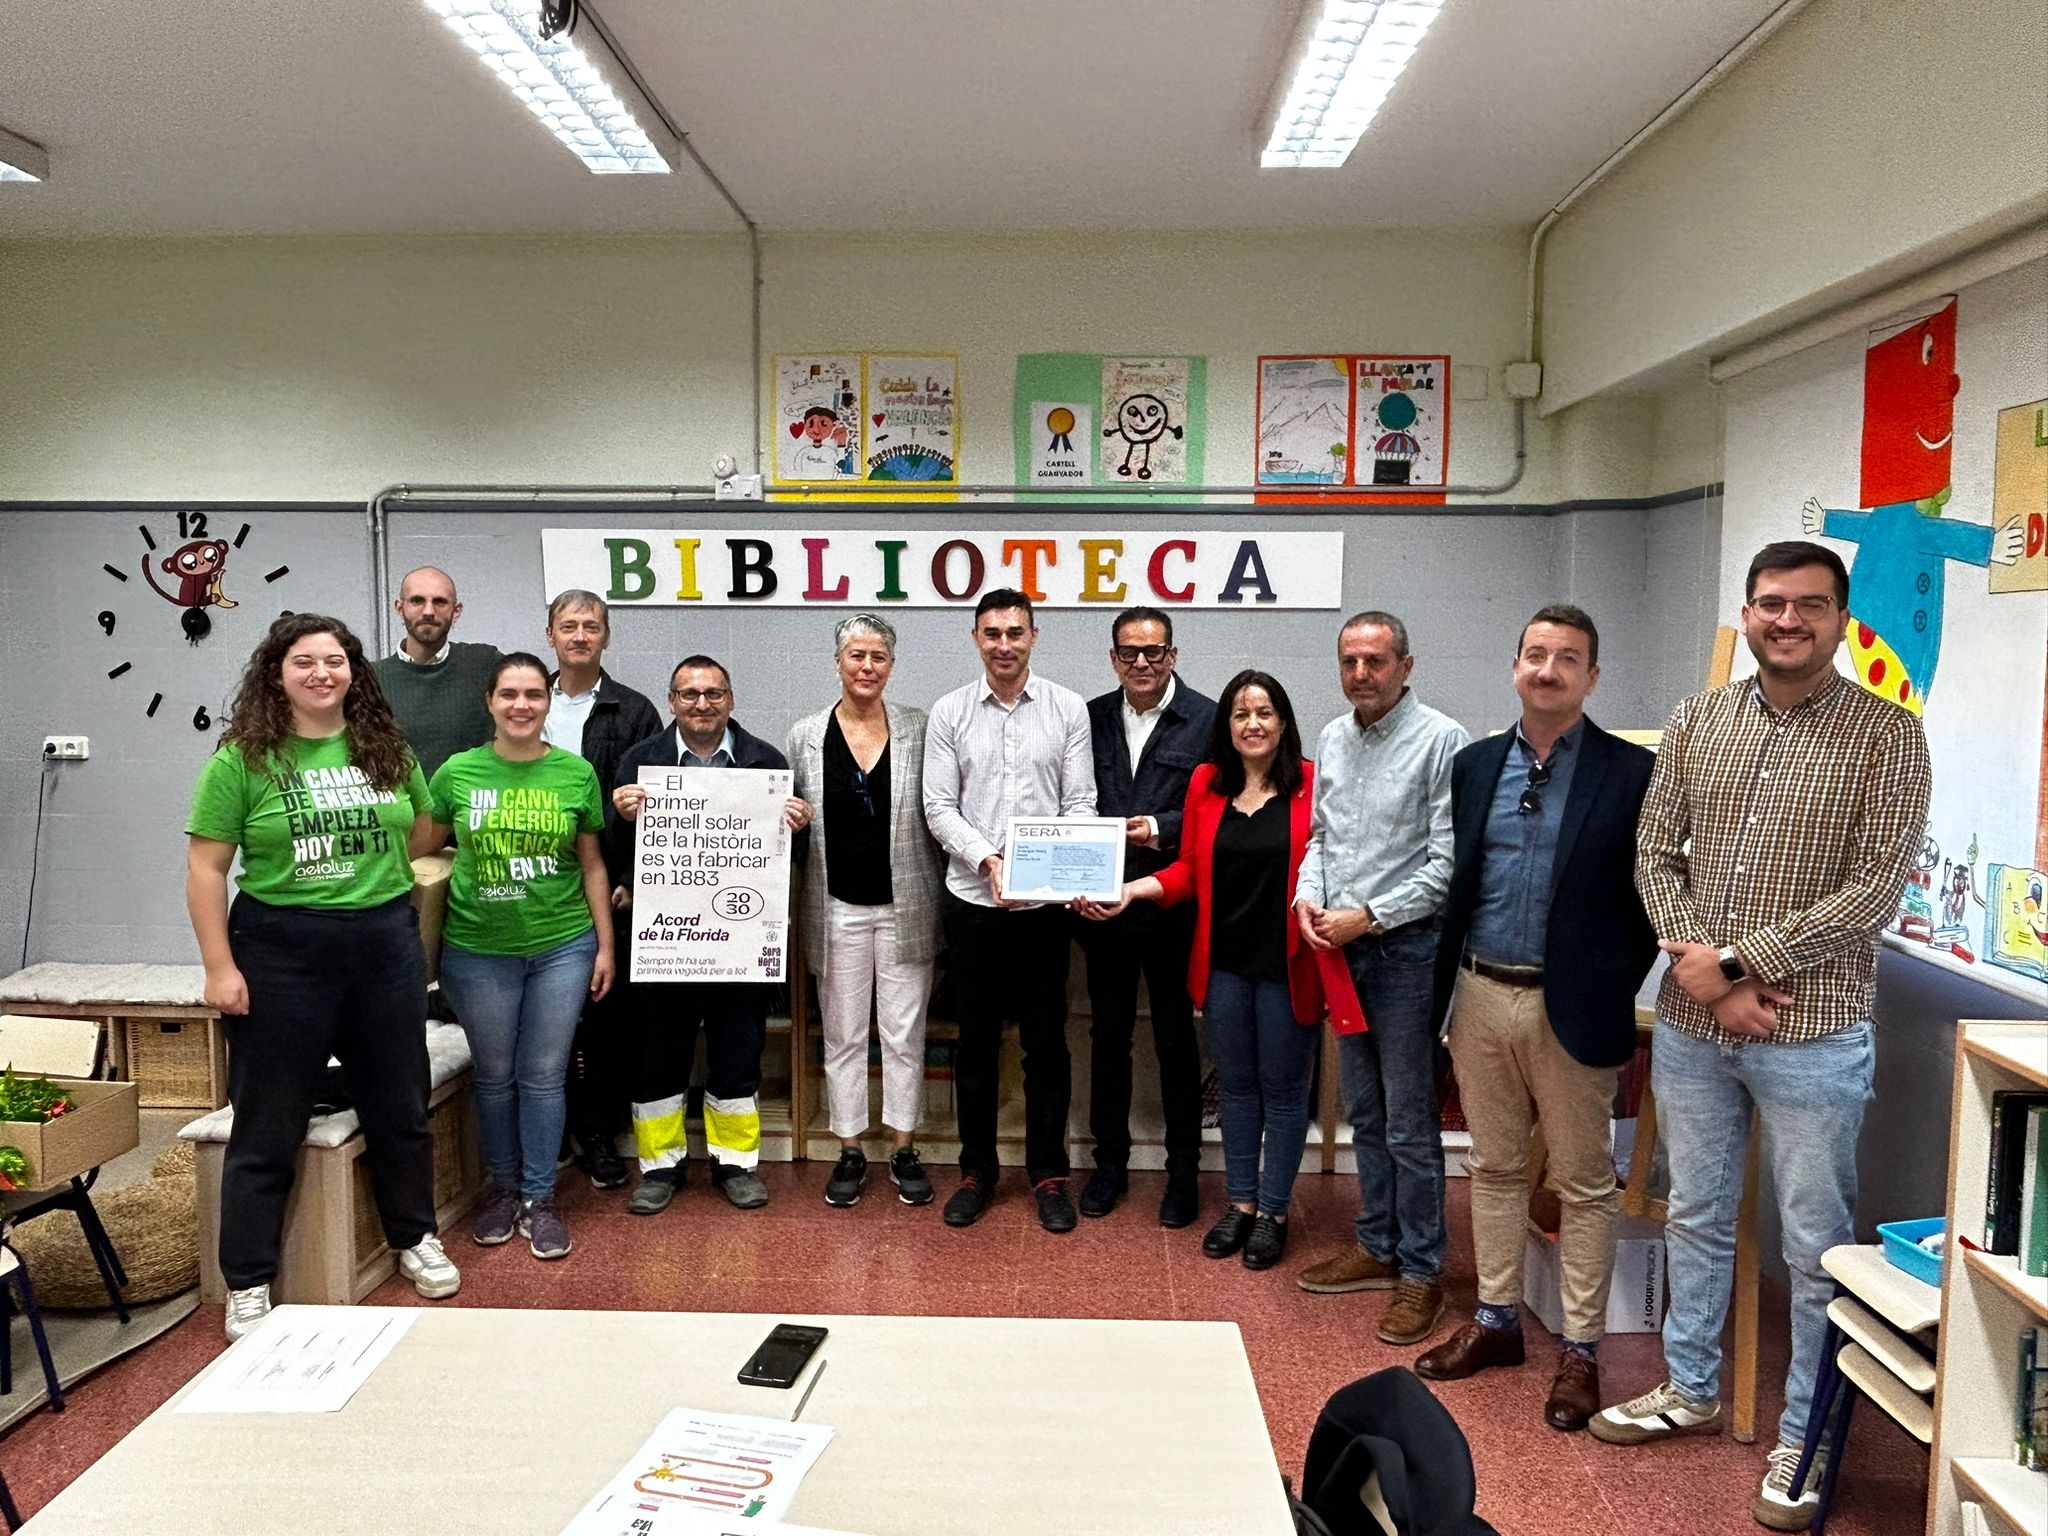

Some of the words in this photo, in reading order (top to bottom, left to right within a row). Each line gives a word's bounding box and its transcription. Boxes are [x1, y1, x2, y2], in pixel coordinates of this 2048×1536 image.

[177, 512, 208, 538] 12
[603, 538, 1277, 603] BIBLIOTECA
[98, 610, 116, 636] 9
[193, 705, 211, 731] 6
[667, 775, 682, 790] El
[281, 791, 312, 813] DE
[470, 789, 498, 809] UN
[502, 788, 560, 810] CANVI
[644, 794, 708, 813] primer
[288, 807, 381, 838] EMPIEZA
[643, 814, 700, 831] panell
[705, 815, 751, 830] solar
[292, 835, 335, 862] HOY
[340, 832, 365, 856] EN
[371, 830, 389, 853] TI
[642, 831, 668, 847] de
[673, 832, 688, 847] la
[693, 833, 762, 850] història
[295, 859, 355, 877] aeioluz
[509, 857, 535, 880] EN
[642, 853, 665, 866] es
[670, 854, 692, 867] va
[698, 852, 771, 868] fabricar
[641, 872, 666, 886] en
[671, 870, 719, 886] 1883
[726, 893, 751, 903] 20
[726, 904, 750, 915] 30
[652, 913, 701, 926] Acord
[638, 929, 658, 941] de
[660, 929, 674, 941] la
[677, 928, 730, 942] Florida
[637, 955, 674, 966] Sempre
[675, 957, 684, 965] hi
[685, 956, 697, 965] ha
[636, 966, 672, 976] primera
[674, 966, 708, 977] vegada
[709, 967, 725, 976] per
[735, 967, 748, 975] tot
